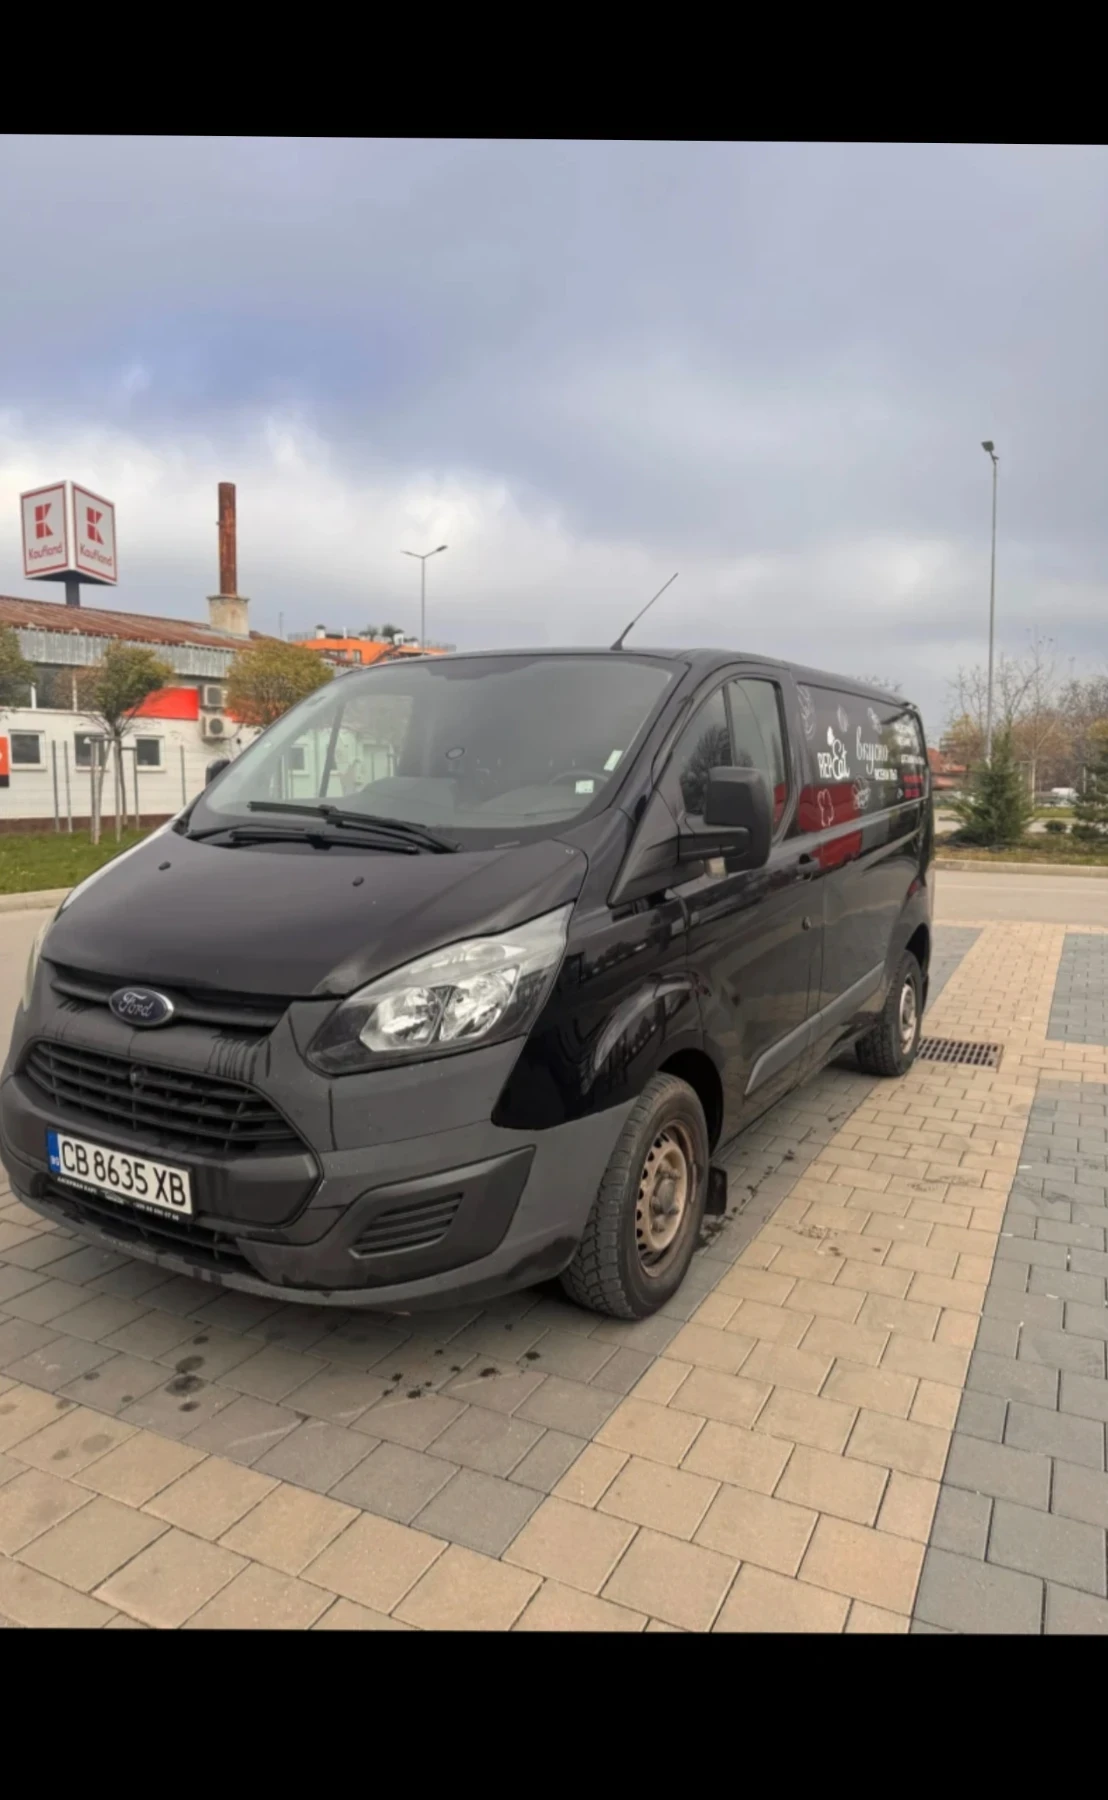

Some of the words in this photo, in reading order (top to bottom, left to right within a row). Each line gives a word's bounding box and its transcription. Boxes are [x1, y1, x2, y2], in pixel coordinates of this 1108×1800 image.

[28, 543, 63, 560] Kaufland
[80, 543, 113, 566] Kaufland
[118, 991, 154, 1017] Ford
[61, 1141, 89, 1176] CB
[93, 1151, 148, 1195] 8635
[153, 1167, 186, 1206] XB
